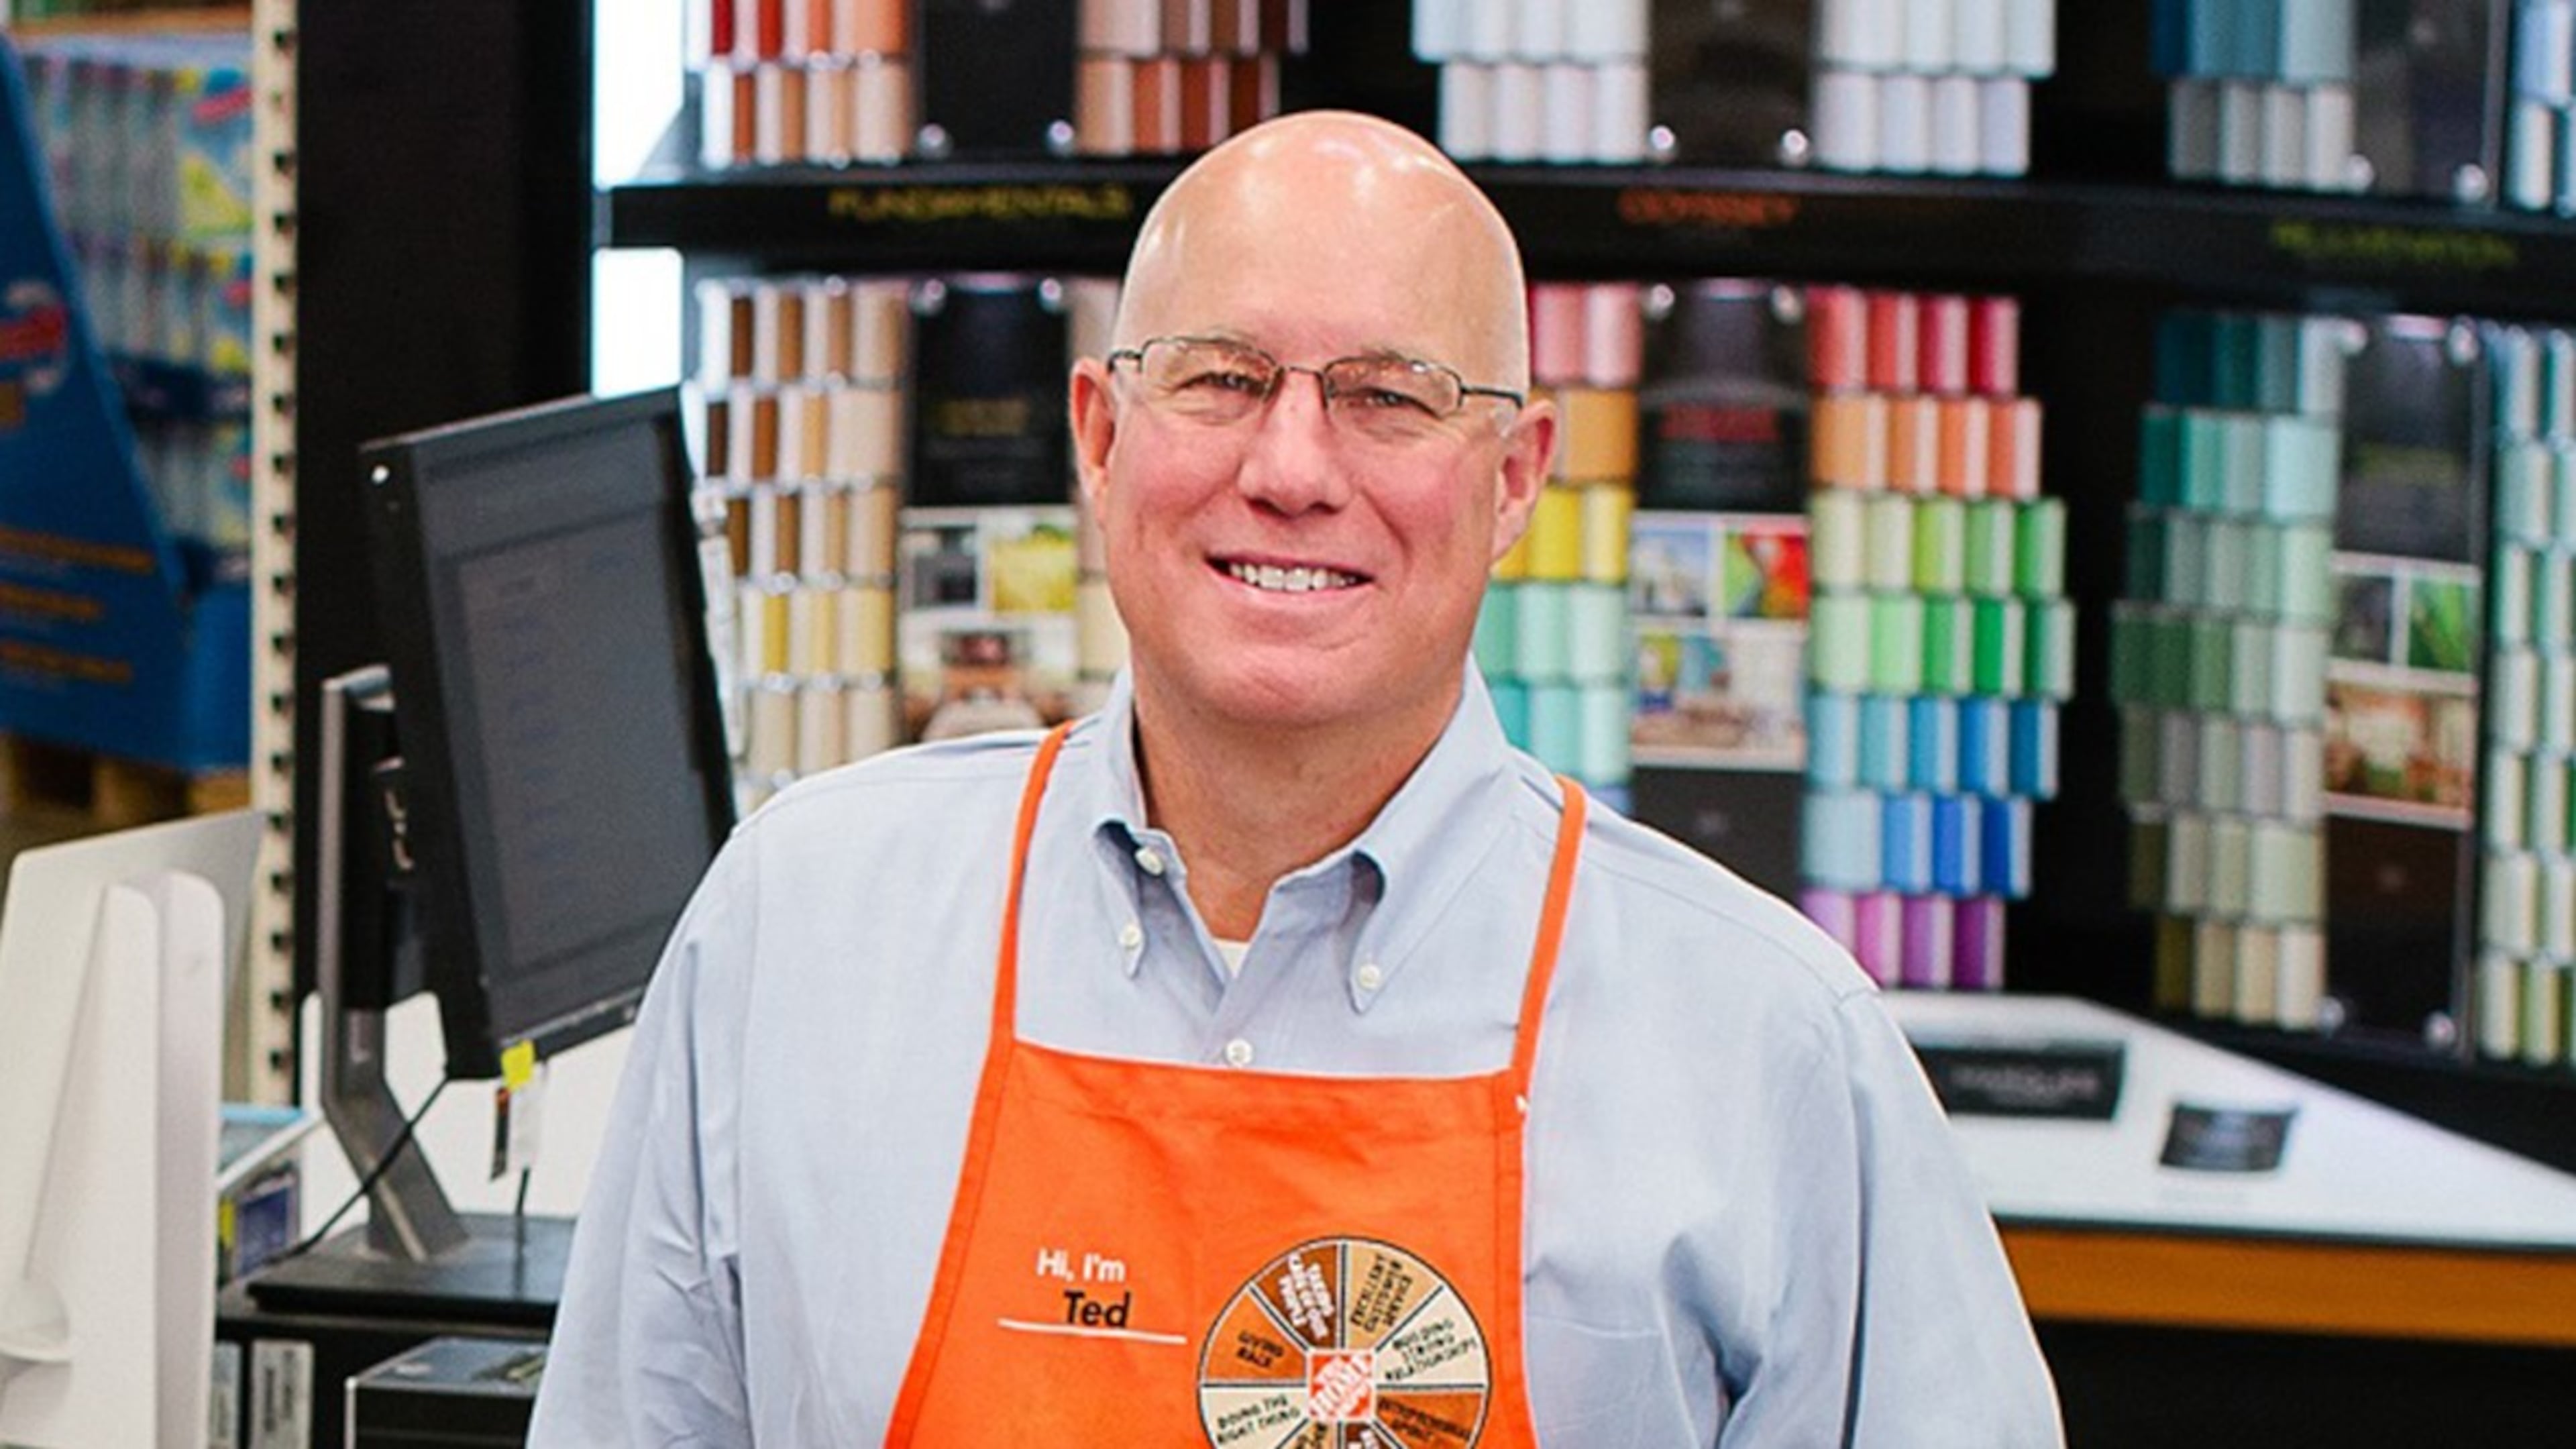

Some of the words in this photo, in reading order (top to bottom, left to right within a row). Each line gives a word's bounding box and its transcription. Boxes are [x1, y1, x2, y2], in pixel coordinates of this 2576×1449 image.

[1036, 1248, 1075, 1282] Hi,
[1083, 1253, 1126, 1282] I'm
[1063, 1289, 1132, 1328] Ted
[1350, 1252, 1384, 1326] EXCELLENT
[1362, 1260, 1403, 1333] CUSTOMER
[1392, 1317, 1454, 1350] BUILDING
[1216, 1419, 1256, 1444] RIGHT
[1256, 1405, 1301, 1430] THING
[1218, 1404, 1261, 1429] DOING
[1263, 1394, 1288, 1411] THE
